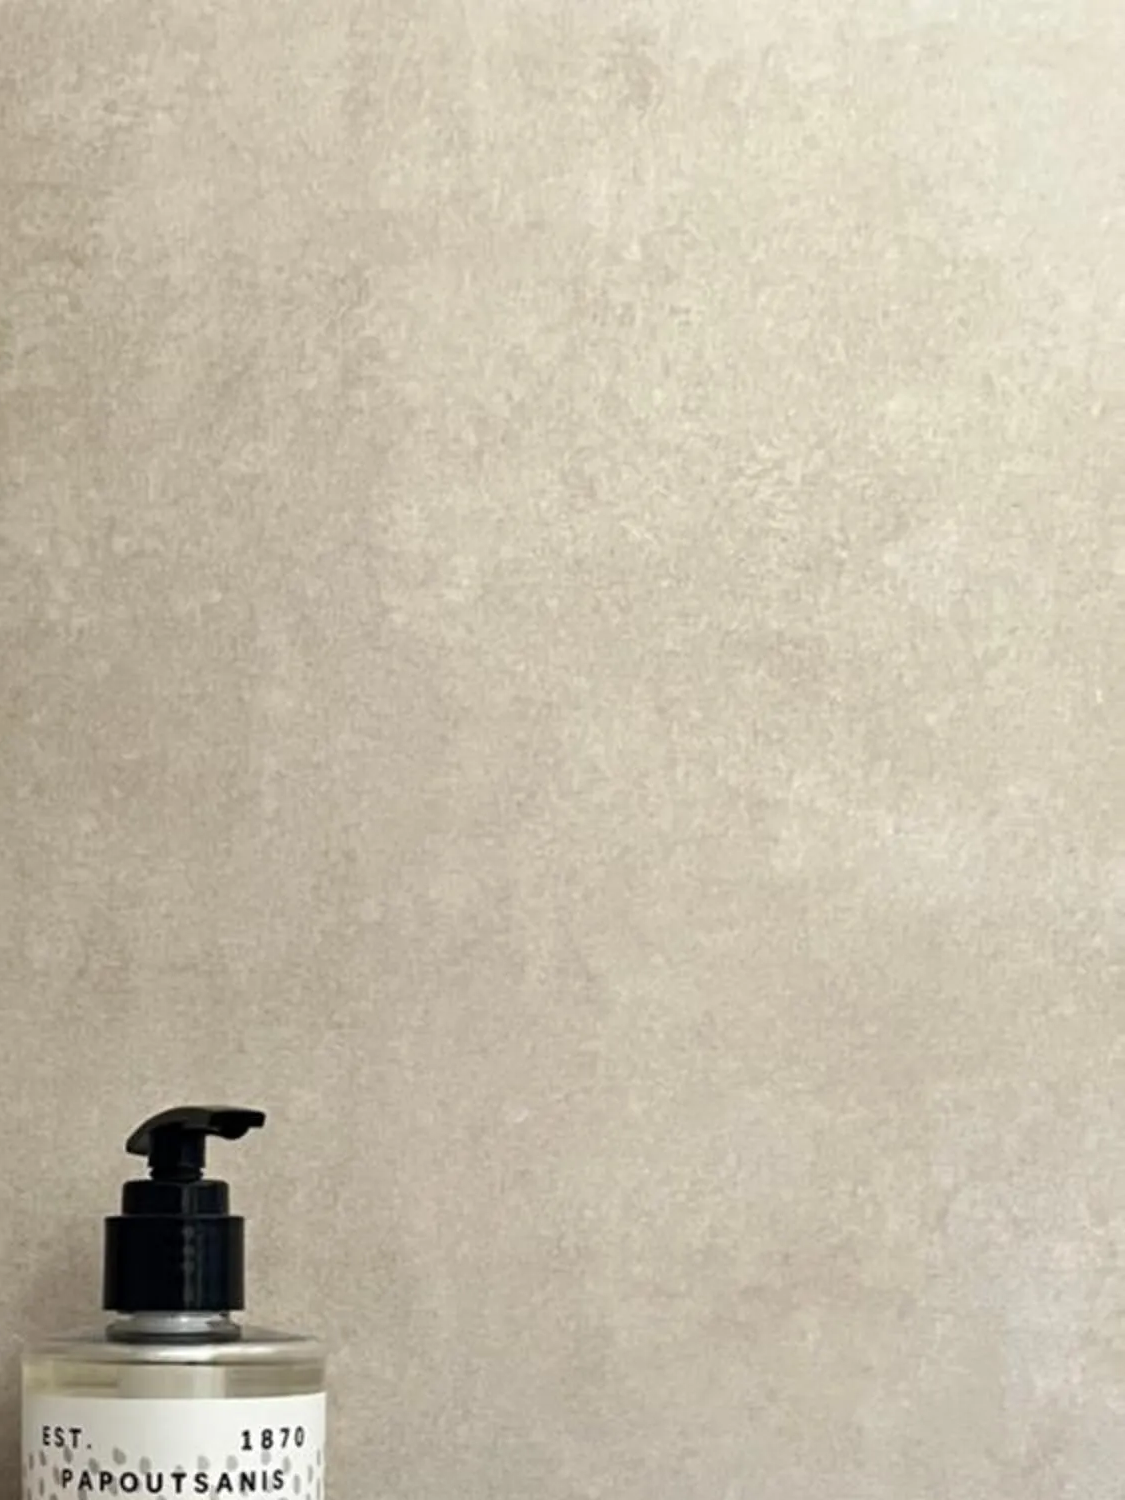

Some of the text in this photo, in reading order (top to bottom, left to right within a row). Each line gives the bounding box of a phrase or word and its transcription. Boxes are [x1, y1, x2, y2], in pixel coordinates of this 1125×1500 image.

[42, 1426, 305, 1450] EST. 1870
[62, 1469, 284, 1494] PAPOUTSANIS
